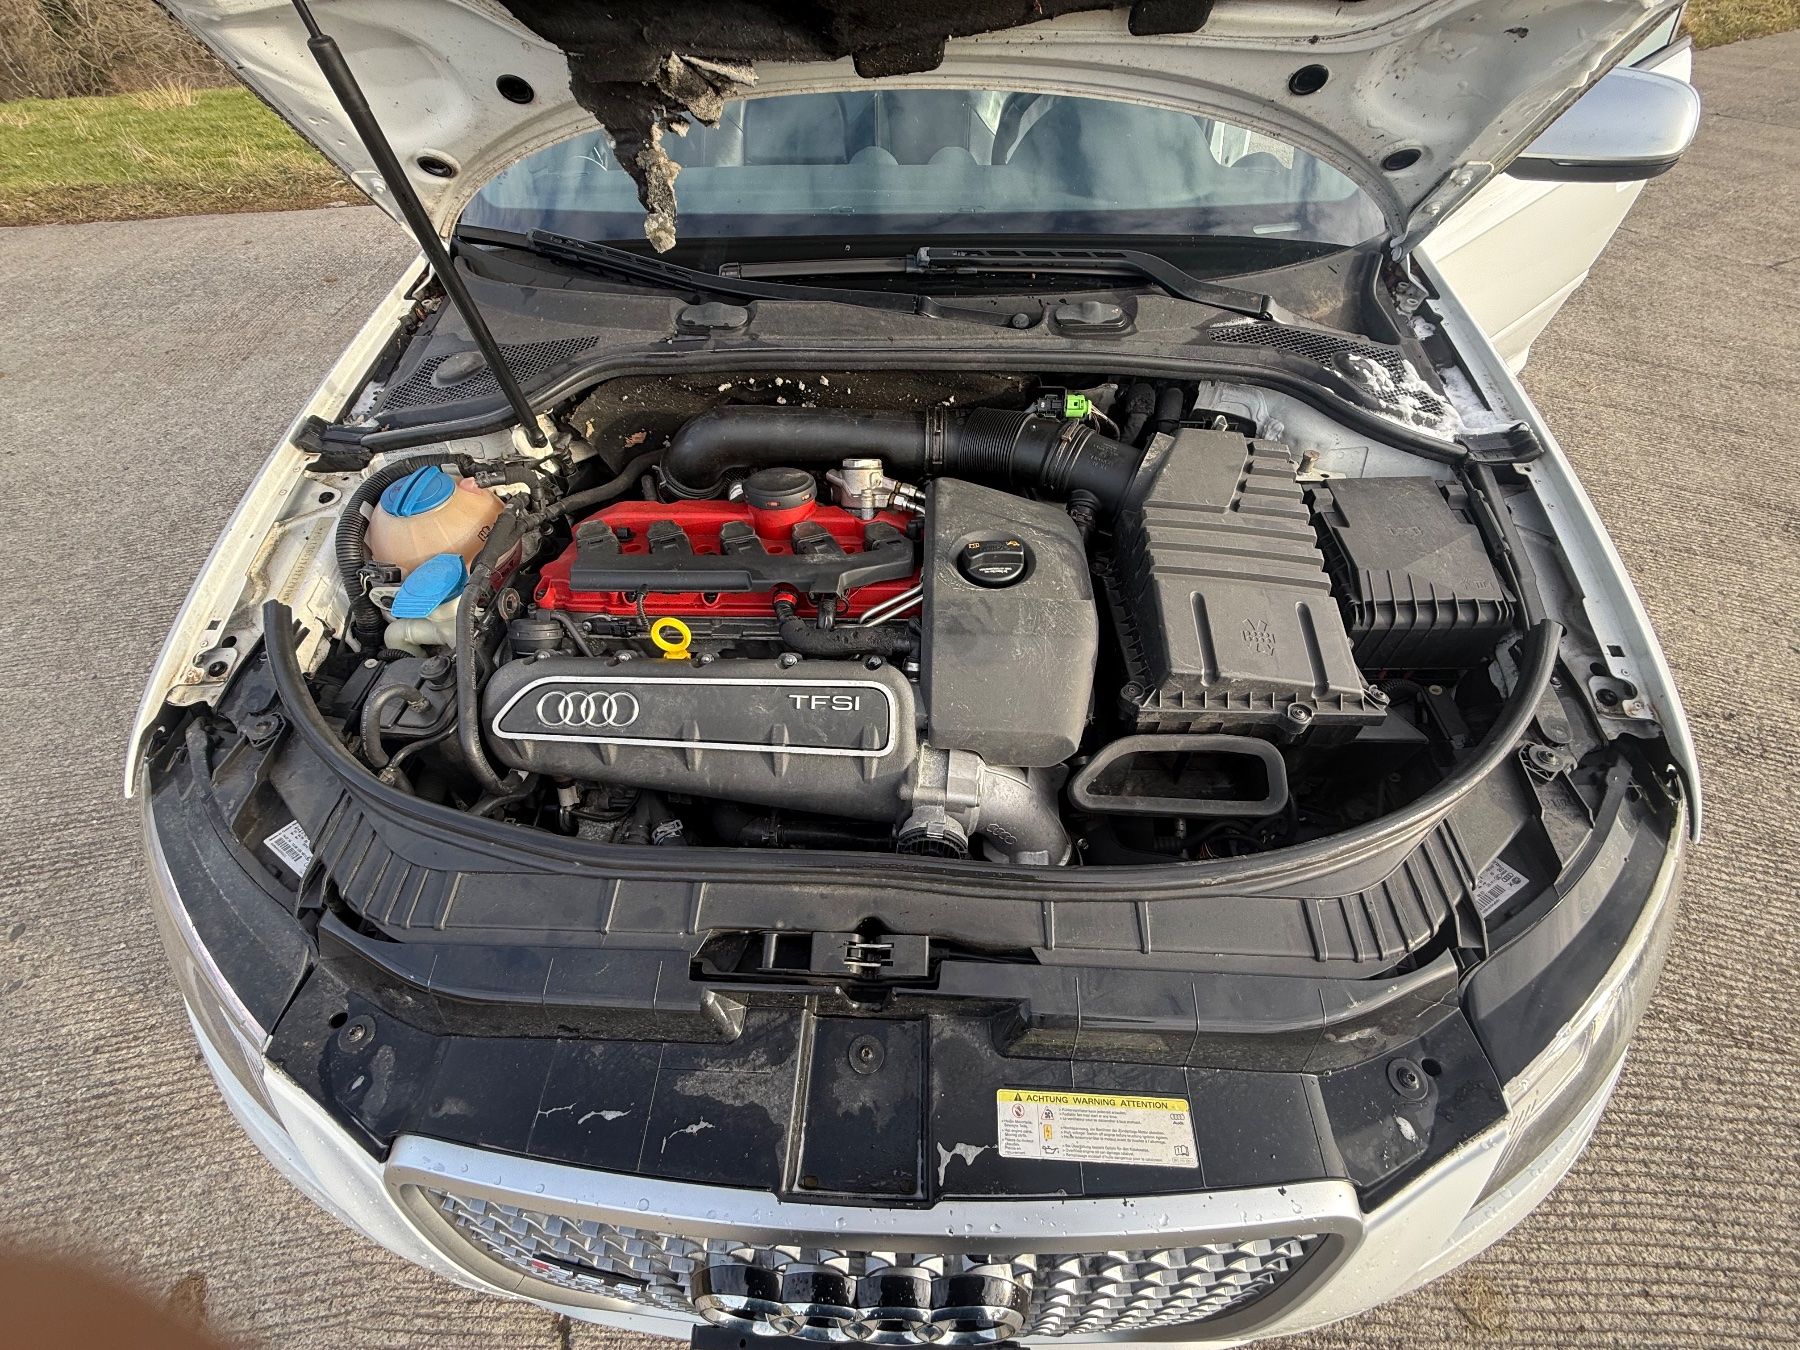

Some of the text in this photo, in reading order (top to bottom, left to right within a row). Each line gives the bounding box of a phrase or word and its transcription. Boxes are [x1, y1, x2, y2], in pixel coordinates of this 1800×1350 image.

[788, 694, 860, 711] TFSI
[1026, 1094, 1168, 1109] ACHTUNG WARNING ATTENTION
